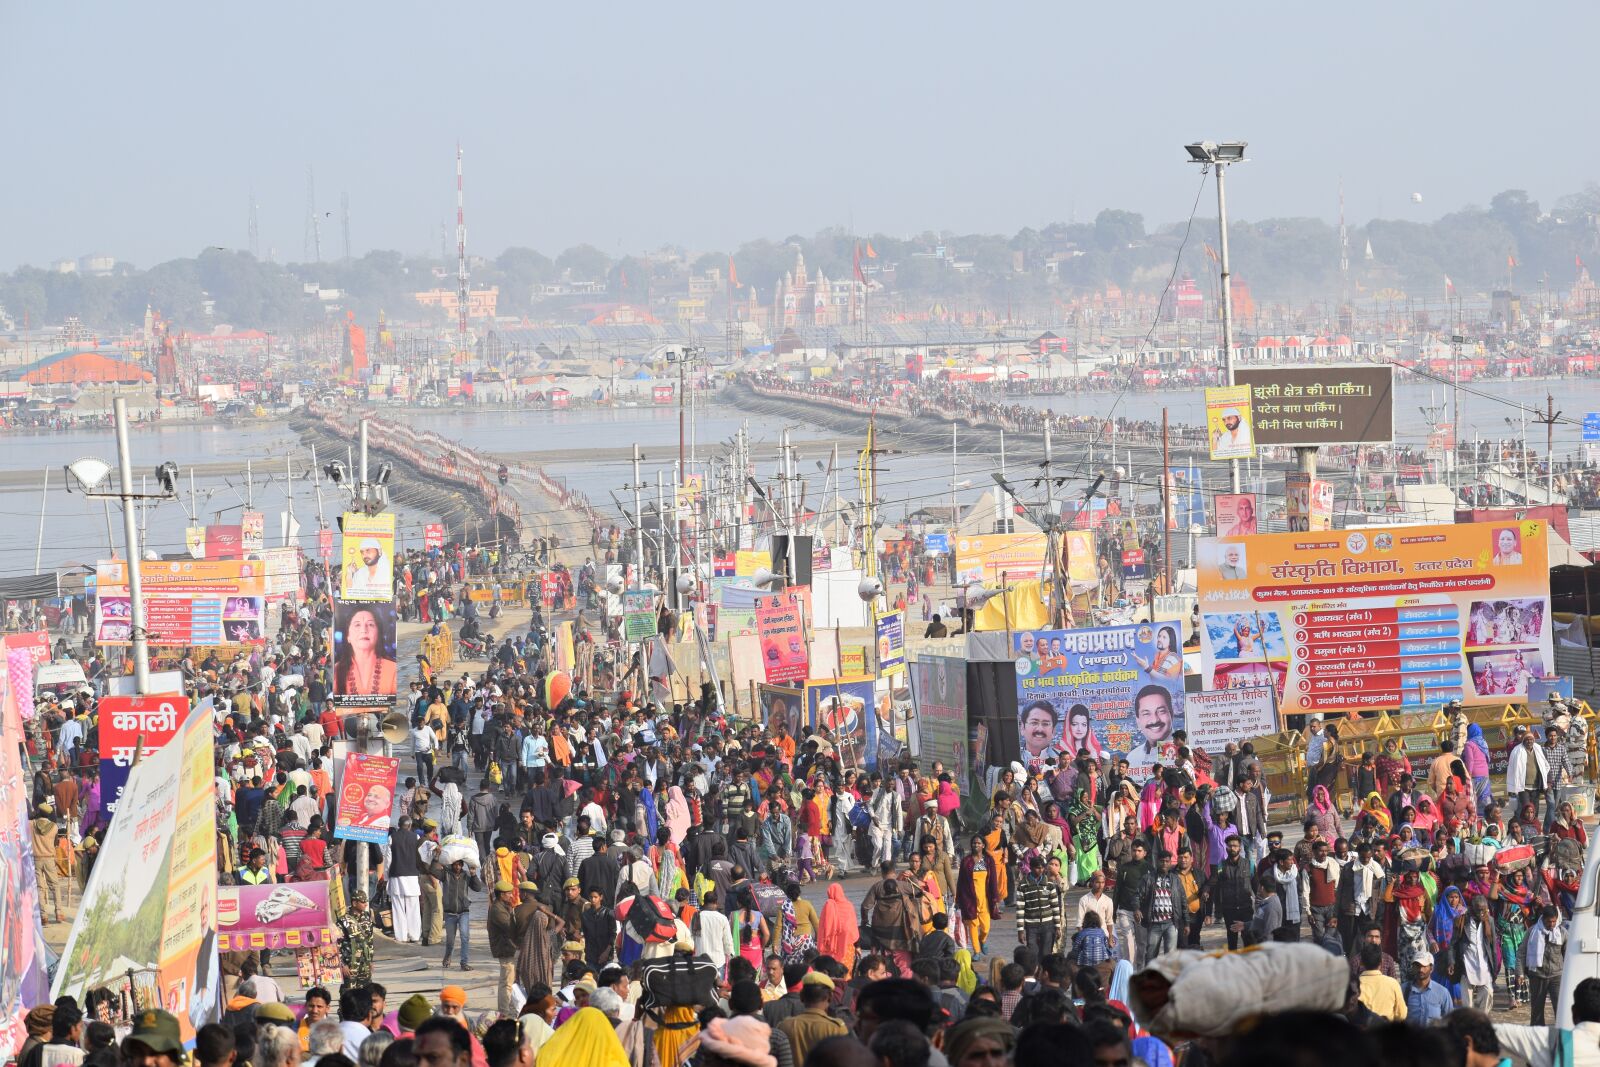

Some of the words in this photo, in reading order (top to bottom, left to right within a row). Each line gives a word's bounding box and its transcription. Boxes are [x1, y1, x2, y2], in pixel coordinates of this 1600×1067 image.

[1284, 384, 1302, 397] क्षेत्र
[1306, 382, 1323, 396] की
[1257, 402, 1280, 414] पटेल
[1258, 419, 1280, 430] चीनी
[1283, 418, 1302, 430] मिल
[1306, 418, 1337, 429] पार्किंग
[1271, 559, 1336, 582] संस्कृति
[1342, 557, 1404, 576] विभाग,
[1414, 561, 1442, 572] उत्तर
[1445, 557, 1473, 570] प्रदेश
[1313, 614, 1344, 623] अक्षयवट
[1064, 628, 1136, 655] महाप्रसाद
[1078, 652, 1127, 668] (भण्डारा)
[1314, 648, 1336, 657] यमुना
[1022, 676, 1035, 689] एवं
[1038, 676, 1054, 688] भव्य
[1057, 670, 1100, 690] सांस्कृतिक
[1102, 668, 1138, 683] कार्यक्रम
[1190, 692, 1237, 704] गरीबदासीय
[1242, 689, 1268, 699] शिविर
[1316, 694, 1344, 705] प्रदर्शनी
[1347, 694, 1358, 704] एवं
[112, 702, 178, 732] काली
